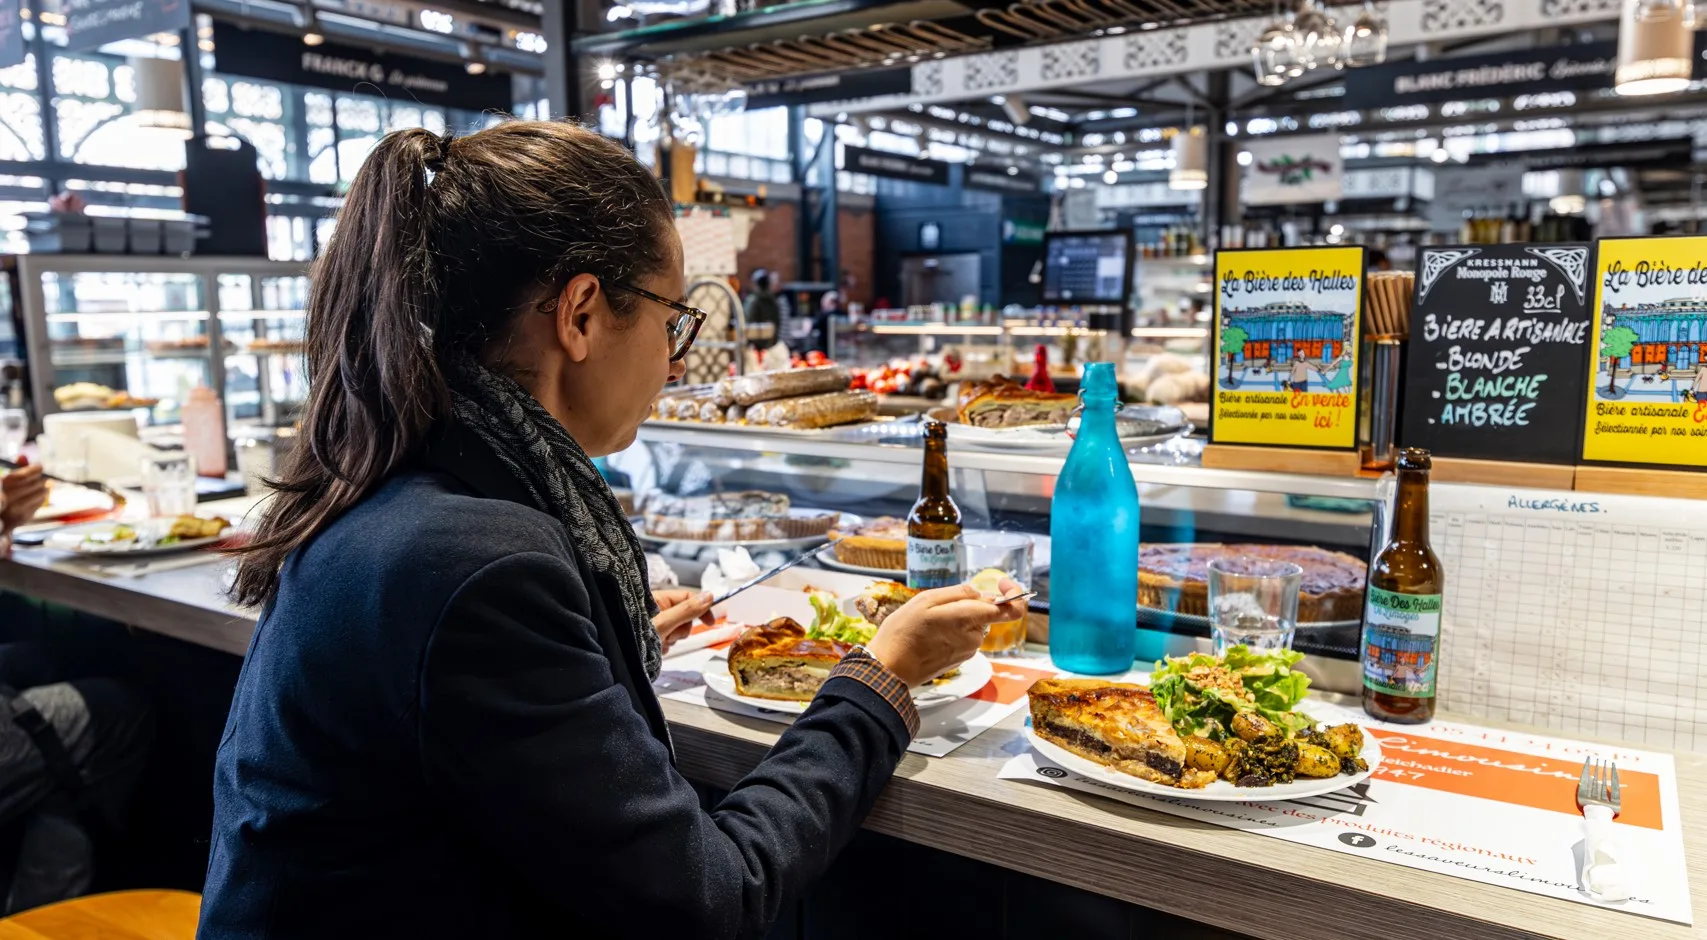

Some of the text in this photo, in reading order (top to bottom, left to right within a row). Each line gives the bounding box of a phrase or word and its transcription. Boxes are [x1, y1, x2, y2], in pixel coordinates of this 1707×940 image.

[1466, 258, 1539, 267] KRESSMANN
[1456, 266, 1548, 283] Monopole Rouge
[1604, 260, 1707, 293] La Bière de
[1221, 269, 1357, 298] La Bière des Halles
[1219, 392, 1288, 405] Bière artisanale
[1290, 388, 1351, 409] En vente
[1595, 402, 1627, 417] Bière
[1630, 404, 1690, 418] artisanale
[1594, 420, 1649, 436] Sélectionnée
[1651, 426, 1668, 438] par
[1671, 426, 1687, 437] nos
[1390, 594, 1411, 610] Des
[1376, 765, 1425, 780] 947
[1282, 808, 1317, 821] des
[1320, 816, 1415, 841] produits
[1420, 836, 1538, 866] régionaux
